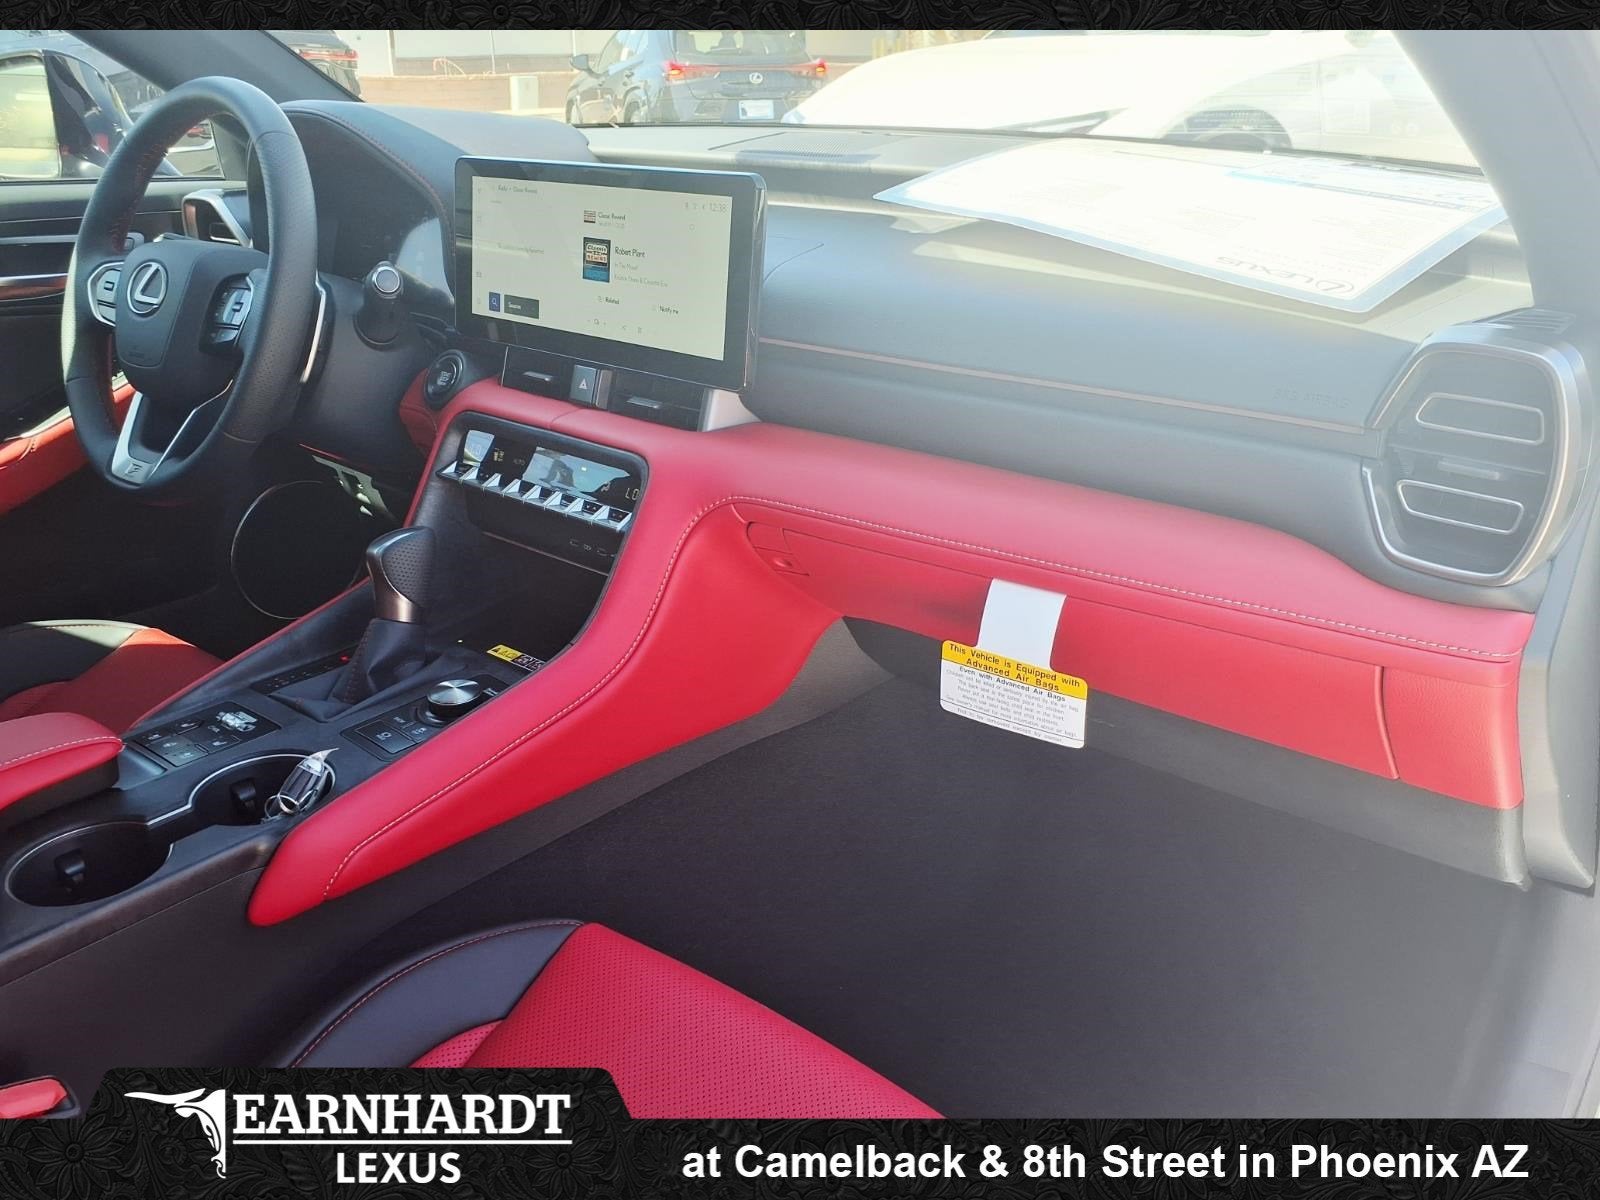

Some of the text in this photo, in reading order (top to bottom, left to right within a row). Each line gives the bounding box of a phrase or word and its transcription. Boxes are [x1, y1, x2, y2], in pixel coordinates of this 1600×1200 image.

[614, 246, 646, 258] Robert Plant
[949, 643, 1080, 688] This Vehicle is Equipped with
[966, 658, 1060, 692] Advanced Air Bags
[959, 665, 1066, 703] Even with Advanced Air Bags
